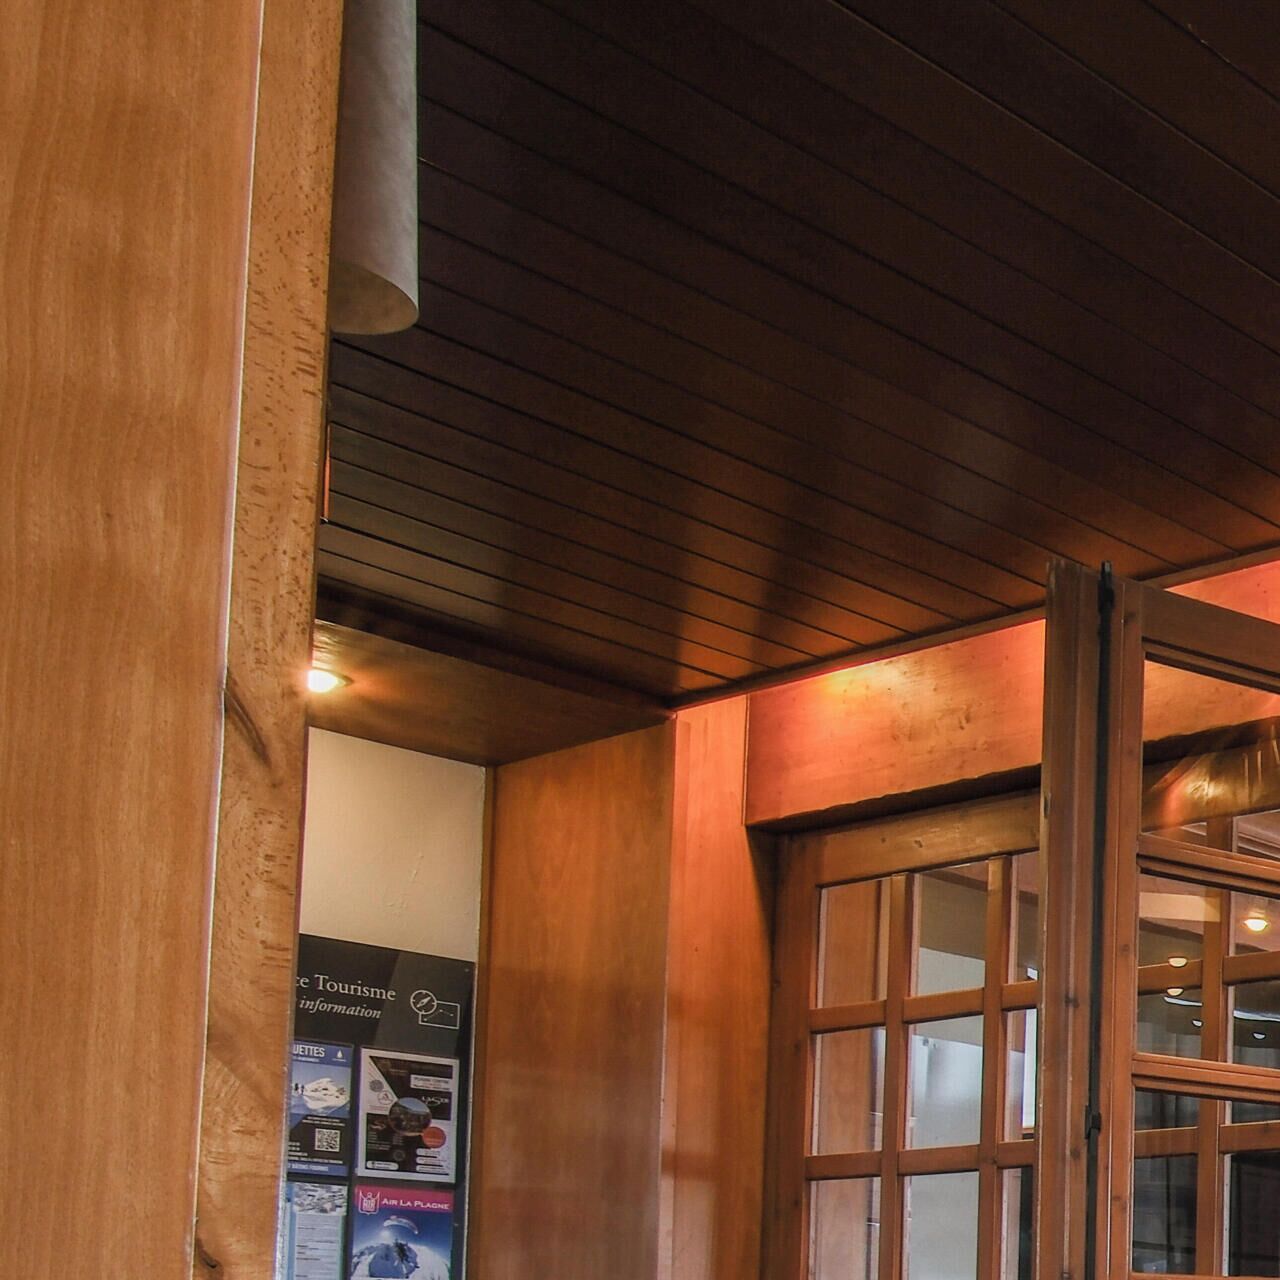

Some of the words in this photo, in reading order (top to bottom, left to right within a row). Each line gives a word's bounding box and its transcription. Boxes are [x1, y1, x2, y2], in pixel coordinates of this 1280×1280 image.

[314, 974, 397, 1001] Tourisme
[300, 995, 382, 1019] information
[381, 1198, 398, 1206] AIR
[400, 1199, 412, 1207] LA
[414, 1200, 450, 1210] PLAGNE
